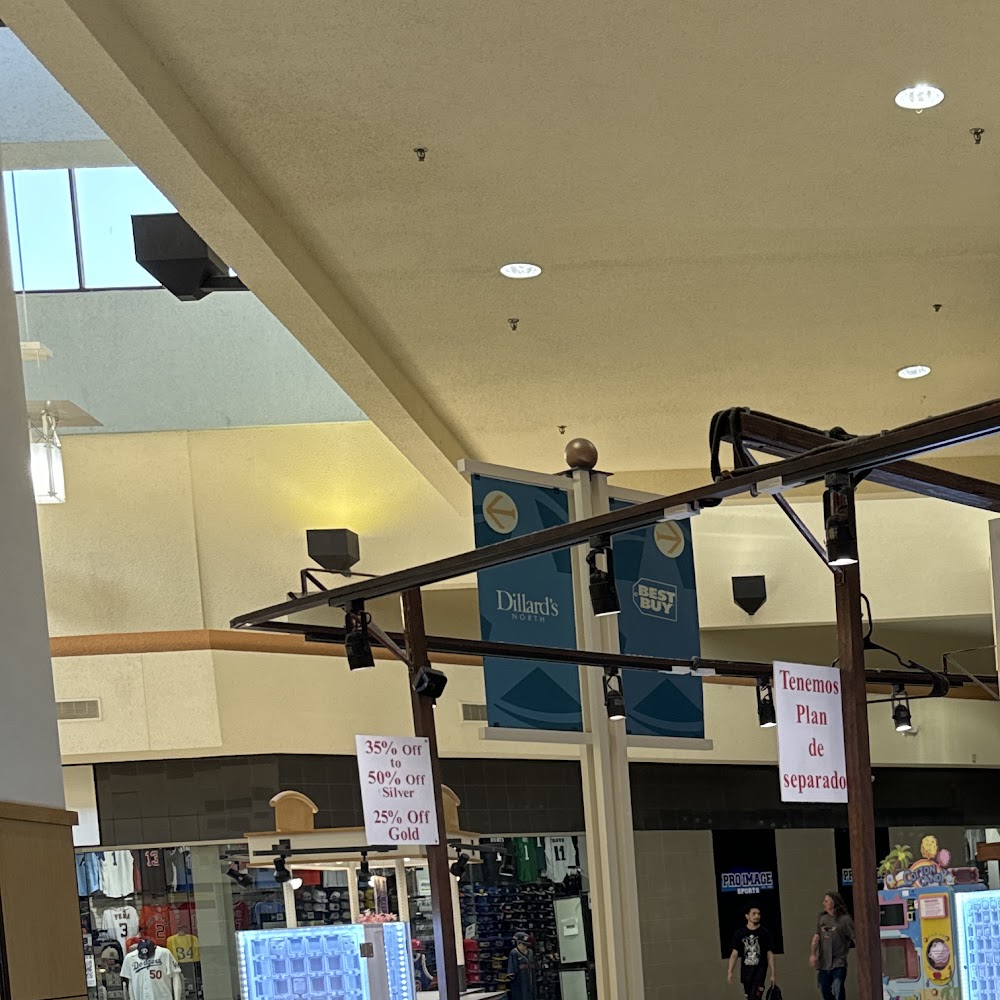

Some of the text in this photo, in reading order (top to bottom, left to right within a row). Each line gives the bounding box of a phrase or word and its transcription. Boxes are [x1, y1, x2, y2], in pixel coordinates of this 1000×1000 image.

[638, 584, 675, 604] BEST
[496, 589, 559, 617] Dillard's
[640, 596, 673, 614] BUY
[511, 613, 545, 623] NORTH
[780, 670, 839, 695] Tenemos
[796, 704, 828, 726] Plan
[365, 740, 422, 756] 35% Off
[808, 738, 824, 757] de
[390, 758, 402, 768] to
[368, 771, 425, 785] 50% Off
[783, 771, 847, 794] separado
[382, 786, 415, 798] Silver
[373, 810, 431, 824] 25% Off
[388, 826, 420, 841] Gold
[144, 850, 160, 867] 13
[553, 845, 567, 861] 11
[721, 871, 773, 887] PRO IMAGE
[903, 865, 937, 887] COTTON
[919, 868, 951, 887] CANDY
[737, 886, 760, 895] SPORTS
[119, 922, 128, 938] 3
[149, 969, 162, 980] 50
